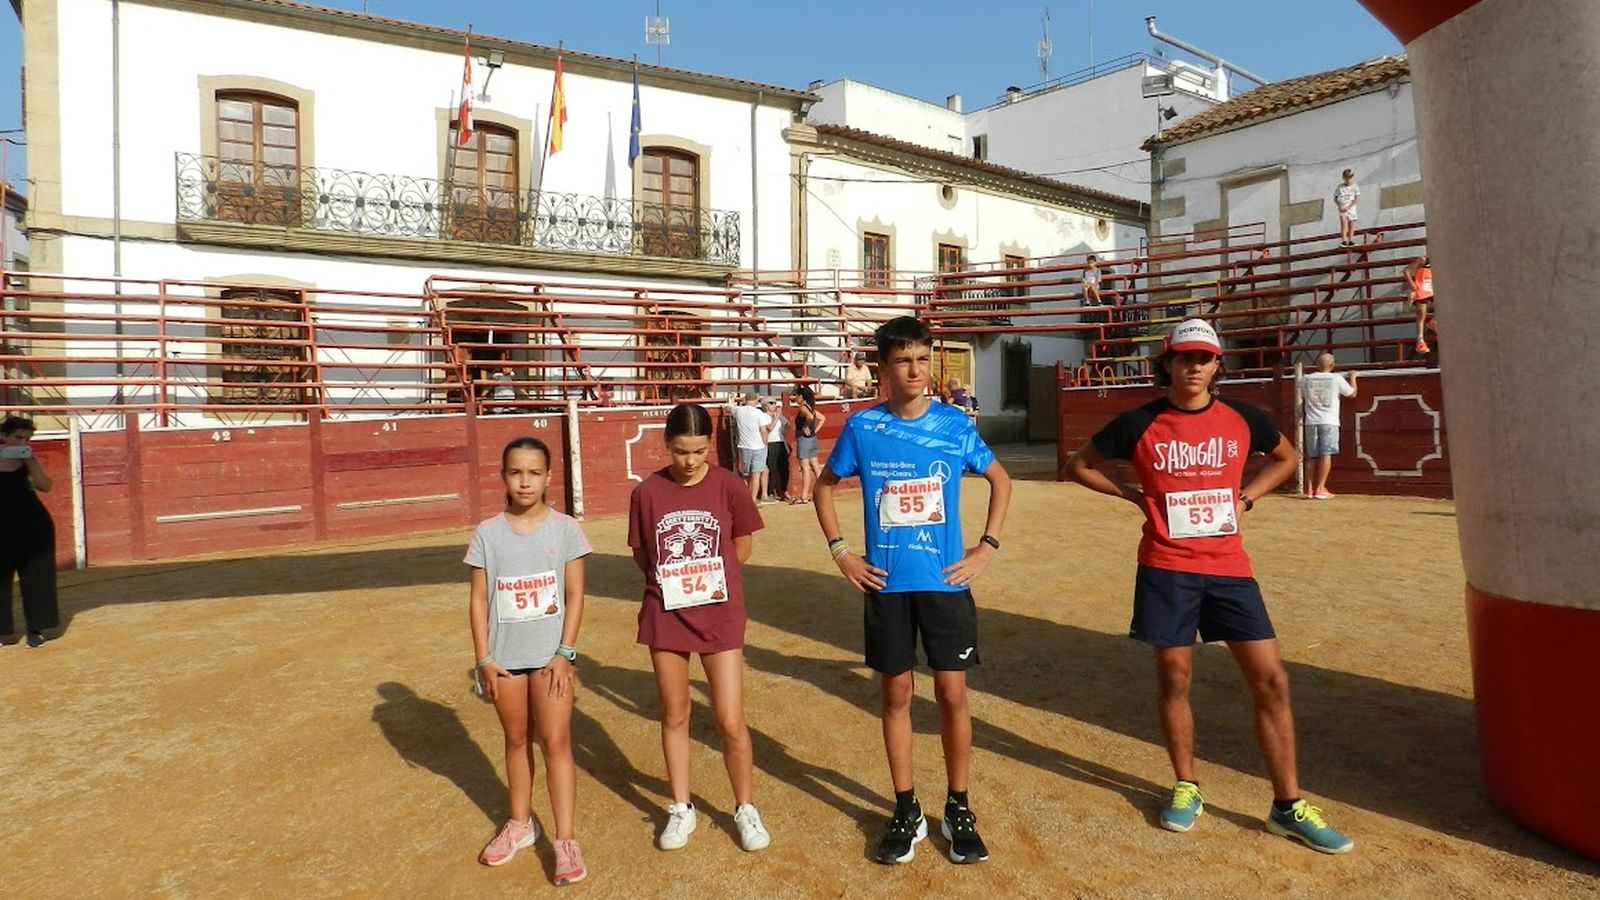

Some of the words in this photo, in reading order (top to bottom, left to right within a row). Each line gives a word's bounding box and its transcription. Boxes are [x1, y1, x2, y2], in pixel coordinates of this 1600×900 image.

[382, 422, 397, 432] 41
[533, 419, 548, 429] 40
[212, 430, 231, 442] 42
[1153, 436, 1227, 474] SABUGAL
[899, 495, 925, 514] 55
[1168, 492, 1231, 507] bedunia
[1189, 506, 1215, 524] 53
[661, 561, 721, 579] bedunia
[497, 575, 556, 591] bedunia
[681, 575, 707, 594] 54
[515, 591, 539, 610] 51
